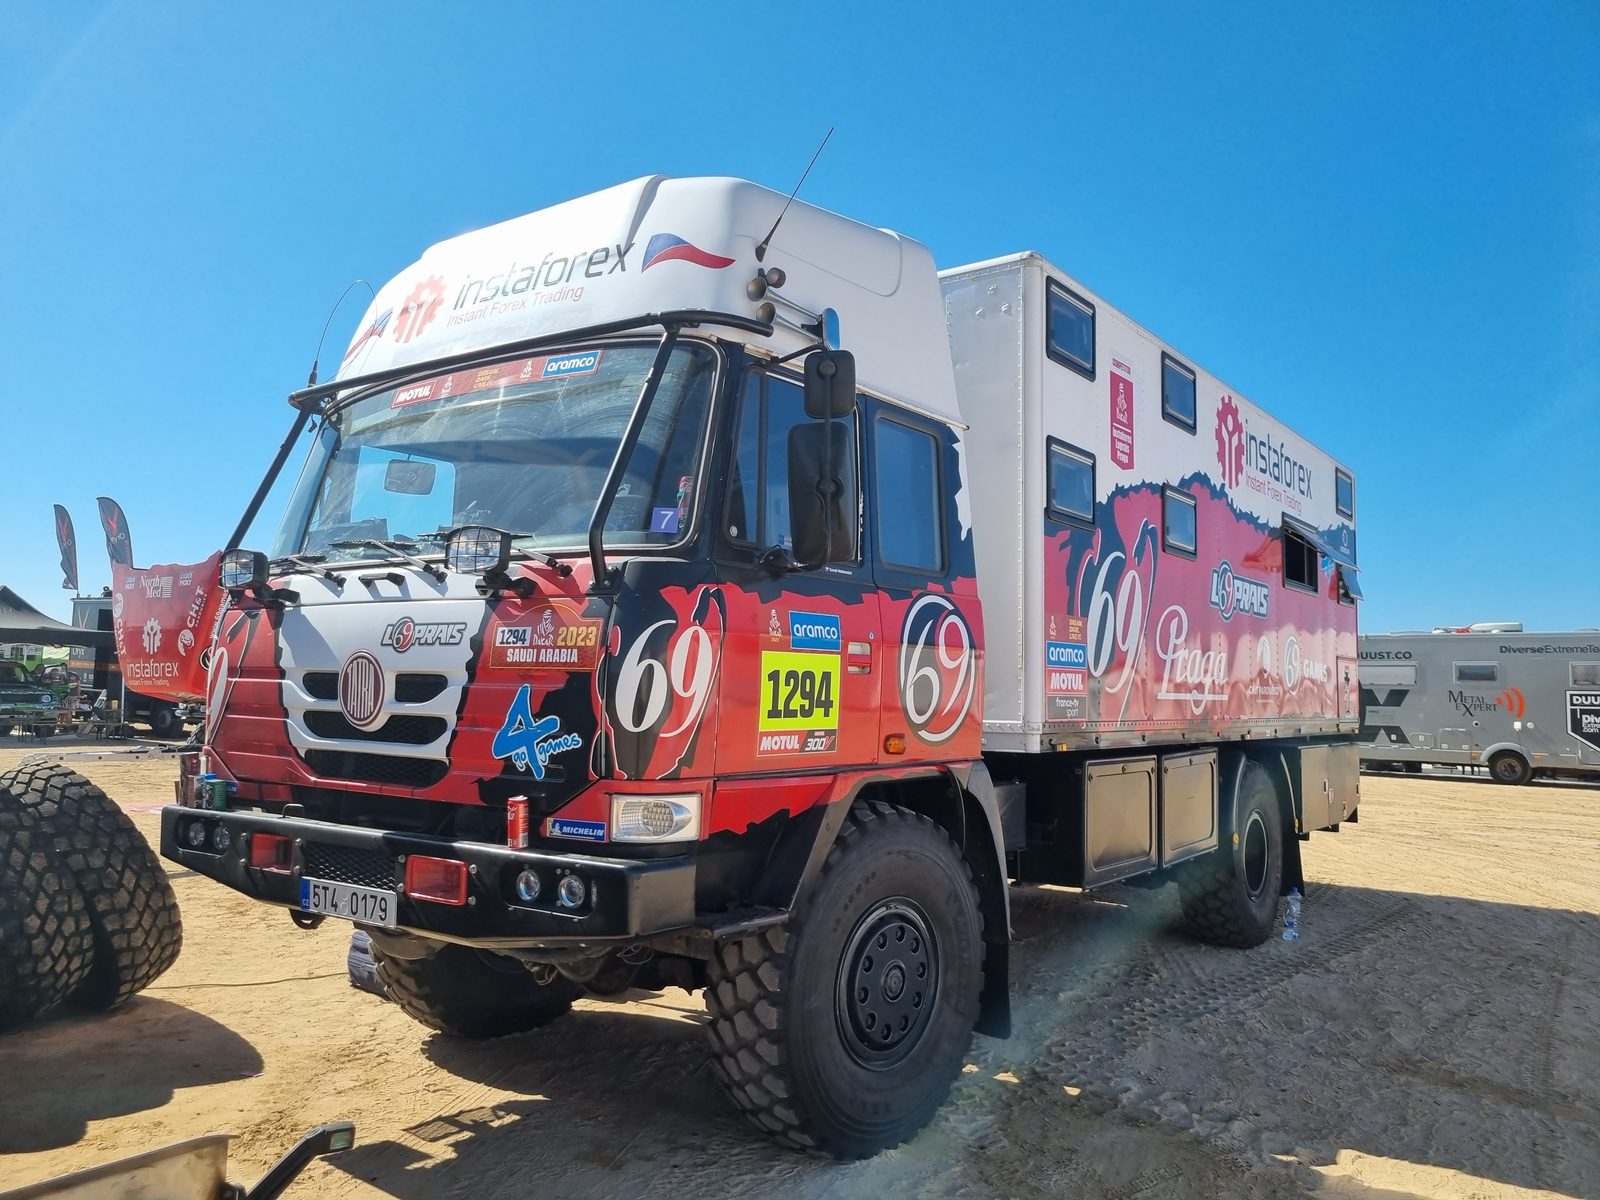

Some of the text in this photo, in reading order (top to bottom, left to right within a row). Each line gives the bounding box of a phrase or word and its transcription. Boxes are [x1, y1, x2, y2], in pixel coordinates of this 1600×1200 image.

[453, 242, 636, 311] instaforex
[447, 286, 585, 328] Instant Forex Trading
[547, 355, 595, 372] aramco
[397, 384, 431, 403] MOTUL
[1245, 418, 1312, 500] instaforex
[660, 511, 674, 529] 7
[793, 623, 838, 639] aramco
[1087, 551, 1143, 694] 69
[499, 628, 527, 645] 1294
[557, 626, 596, 646] 2023
[506, 648, 578, 663] SAUDI ARABIA
[1049, 646, 1084, 663] aramco
[1156, 604, 1229, 715] Praga
[1358, 651, 1412, 660] UUST.CO
[127, 659, 179, 678] instaforex
[900, 594, 976, 742] 69
[347, 658, 375, 719] TATRA
[615, 619, 714, 738] 69
[1050, 672, 1084, 691] MOTUL
[767, 669, 834, 719] 1294
[537, 732, 583, 766] games
[760, 735, 835, 751] MOTUL 300V
[562, 826, 604, 836] MICHELIN
[313, 884, 338, 912] 5T4
[350, 891, 388, 922] 0179
